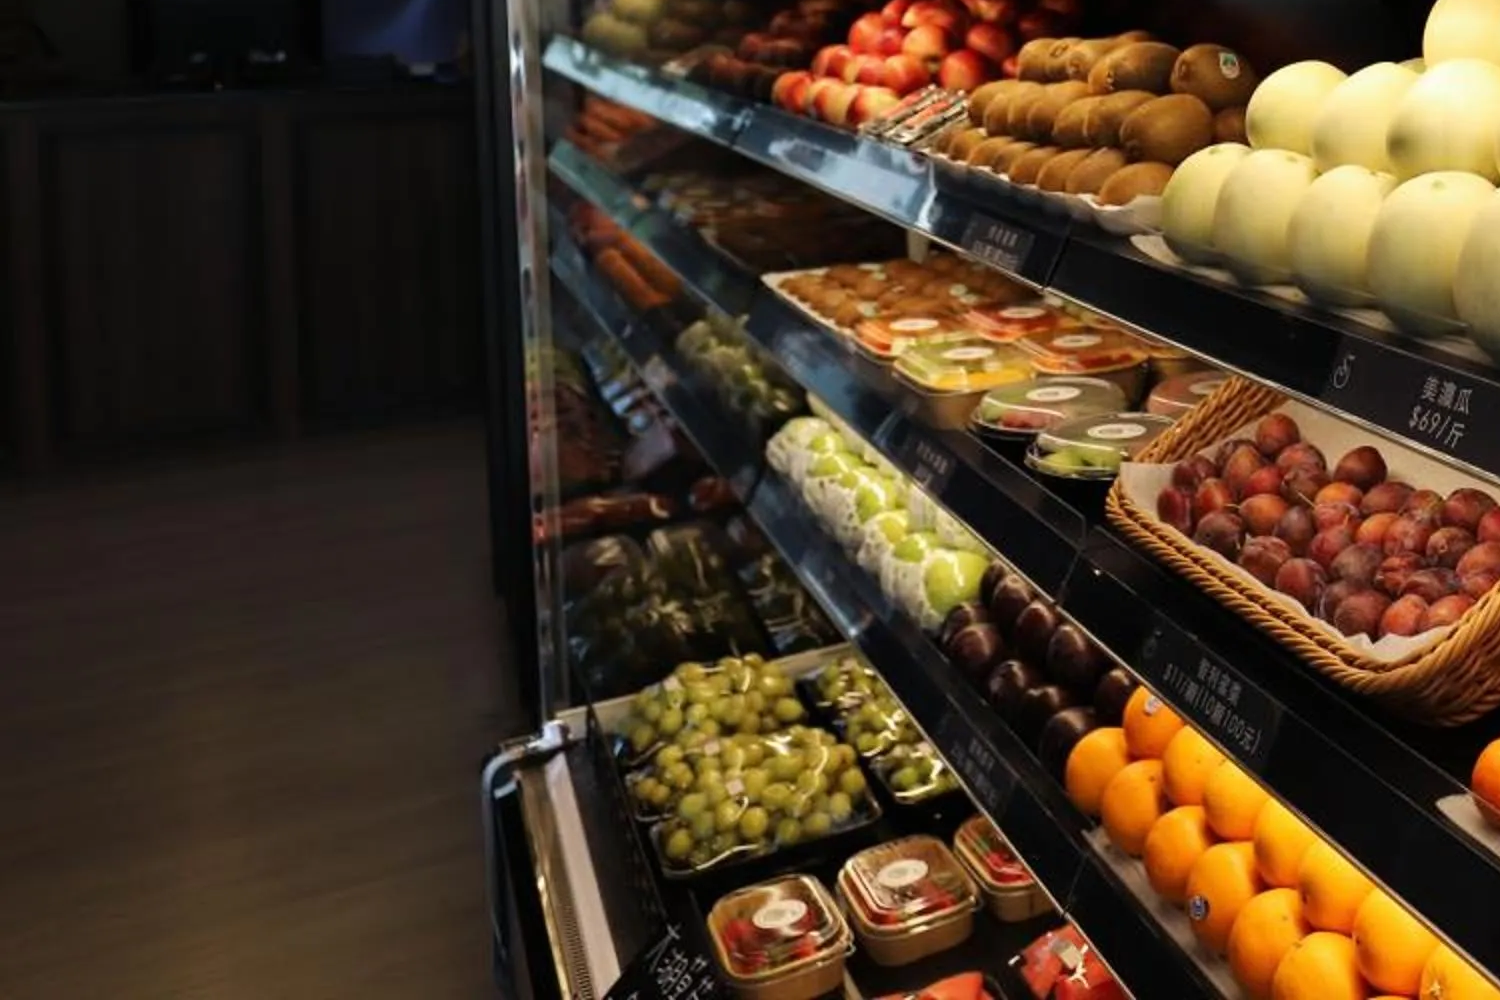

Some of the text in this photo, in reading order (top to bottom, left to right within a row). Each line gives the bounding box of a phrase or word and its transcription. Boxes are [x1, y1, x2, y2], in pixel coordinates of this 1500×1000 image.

[1419, 375, 1474, 416] 美濃瓜
[1408, 404, 1465, 449] $69/斤
